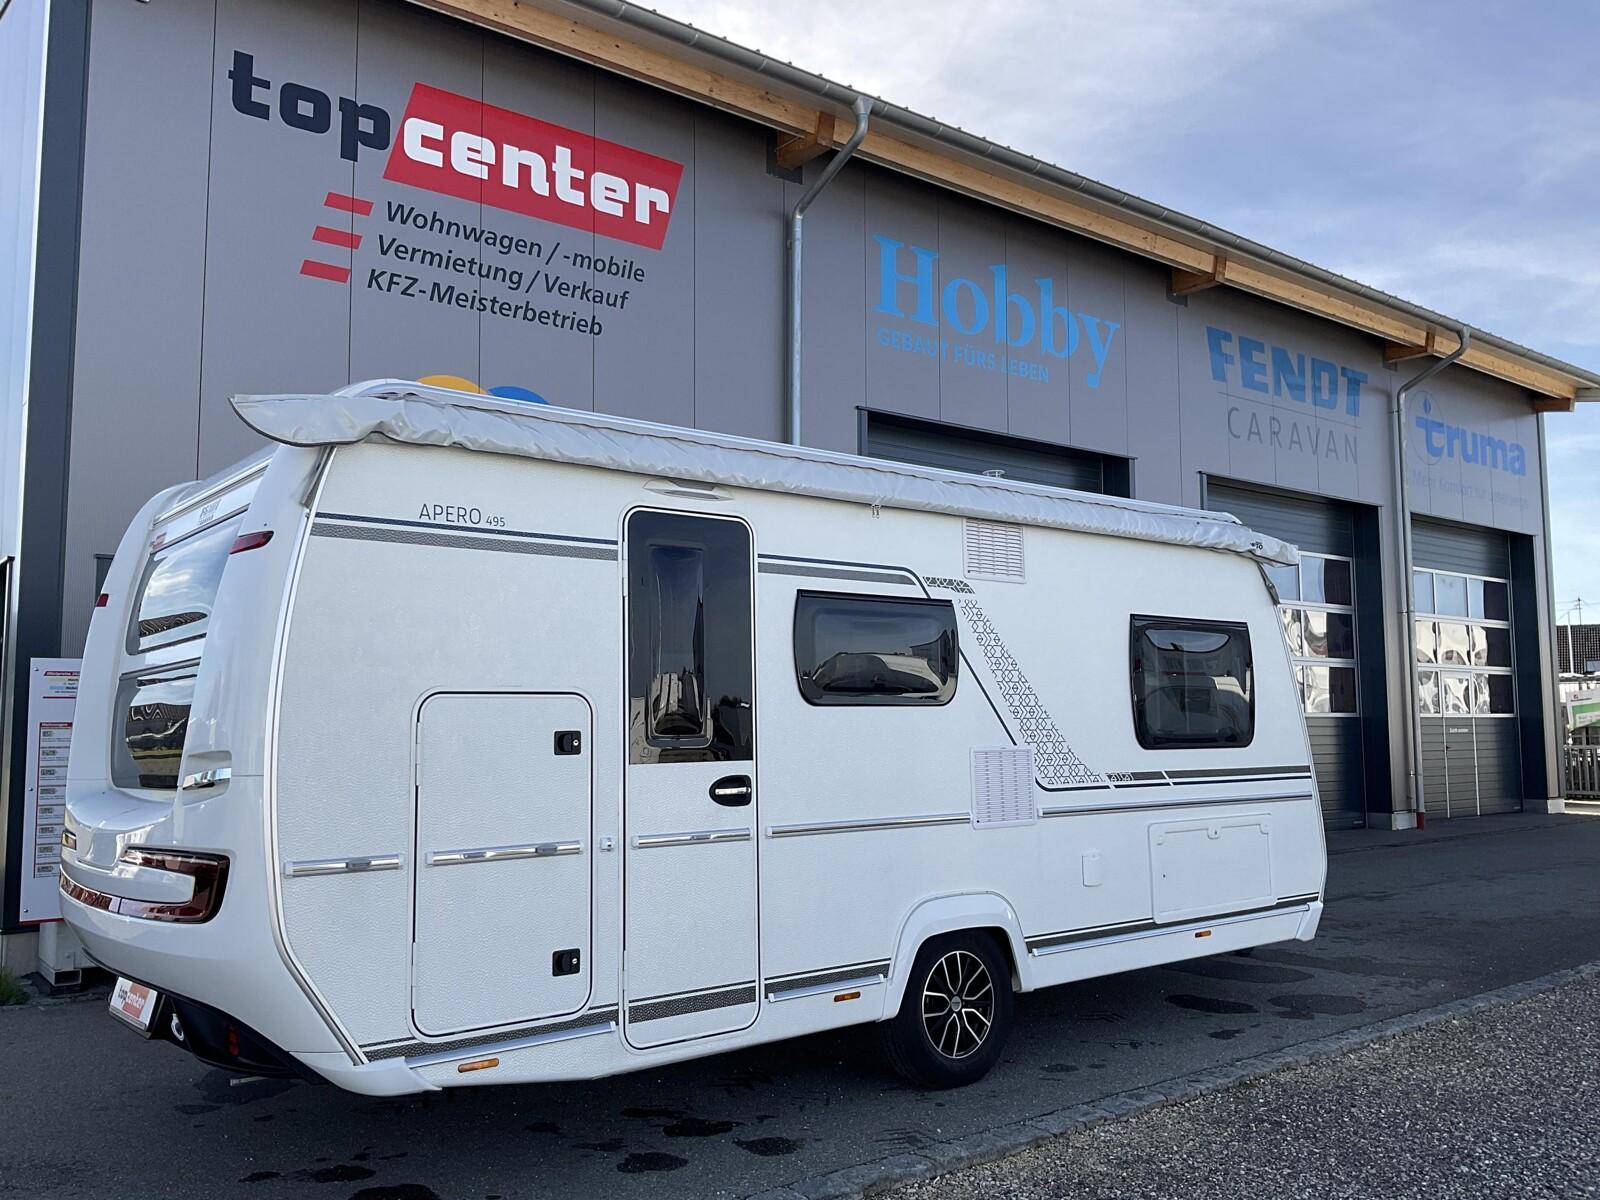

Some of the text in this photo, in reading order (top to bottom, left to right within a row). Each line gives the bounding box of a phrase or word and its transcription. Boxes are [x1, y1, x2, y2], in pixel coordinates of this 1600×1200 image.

[367, 268, 604, 336] KFZ-Meisterbetrieb
[872, 232, 1120, 388] Hobby
[876, 325, 1049, 383] GEBAUT FÜRS LEBEN
[1206, 326, 1368, 417] FENDT
[1227, 406, 1360, 465] CARAVAN
[1415, 412, 1527, 477] truma
[418, 503, 506, 527] APERO 495
